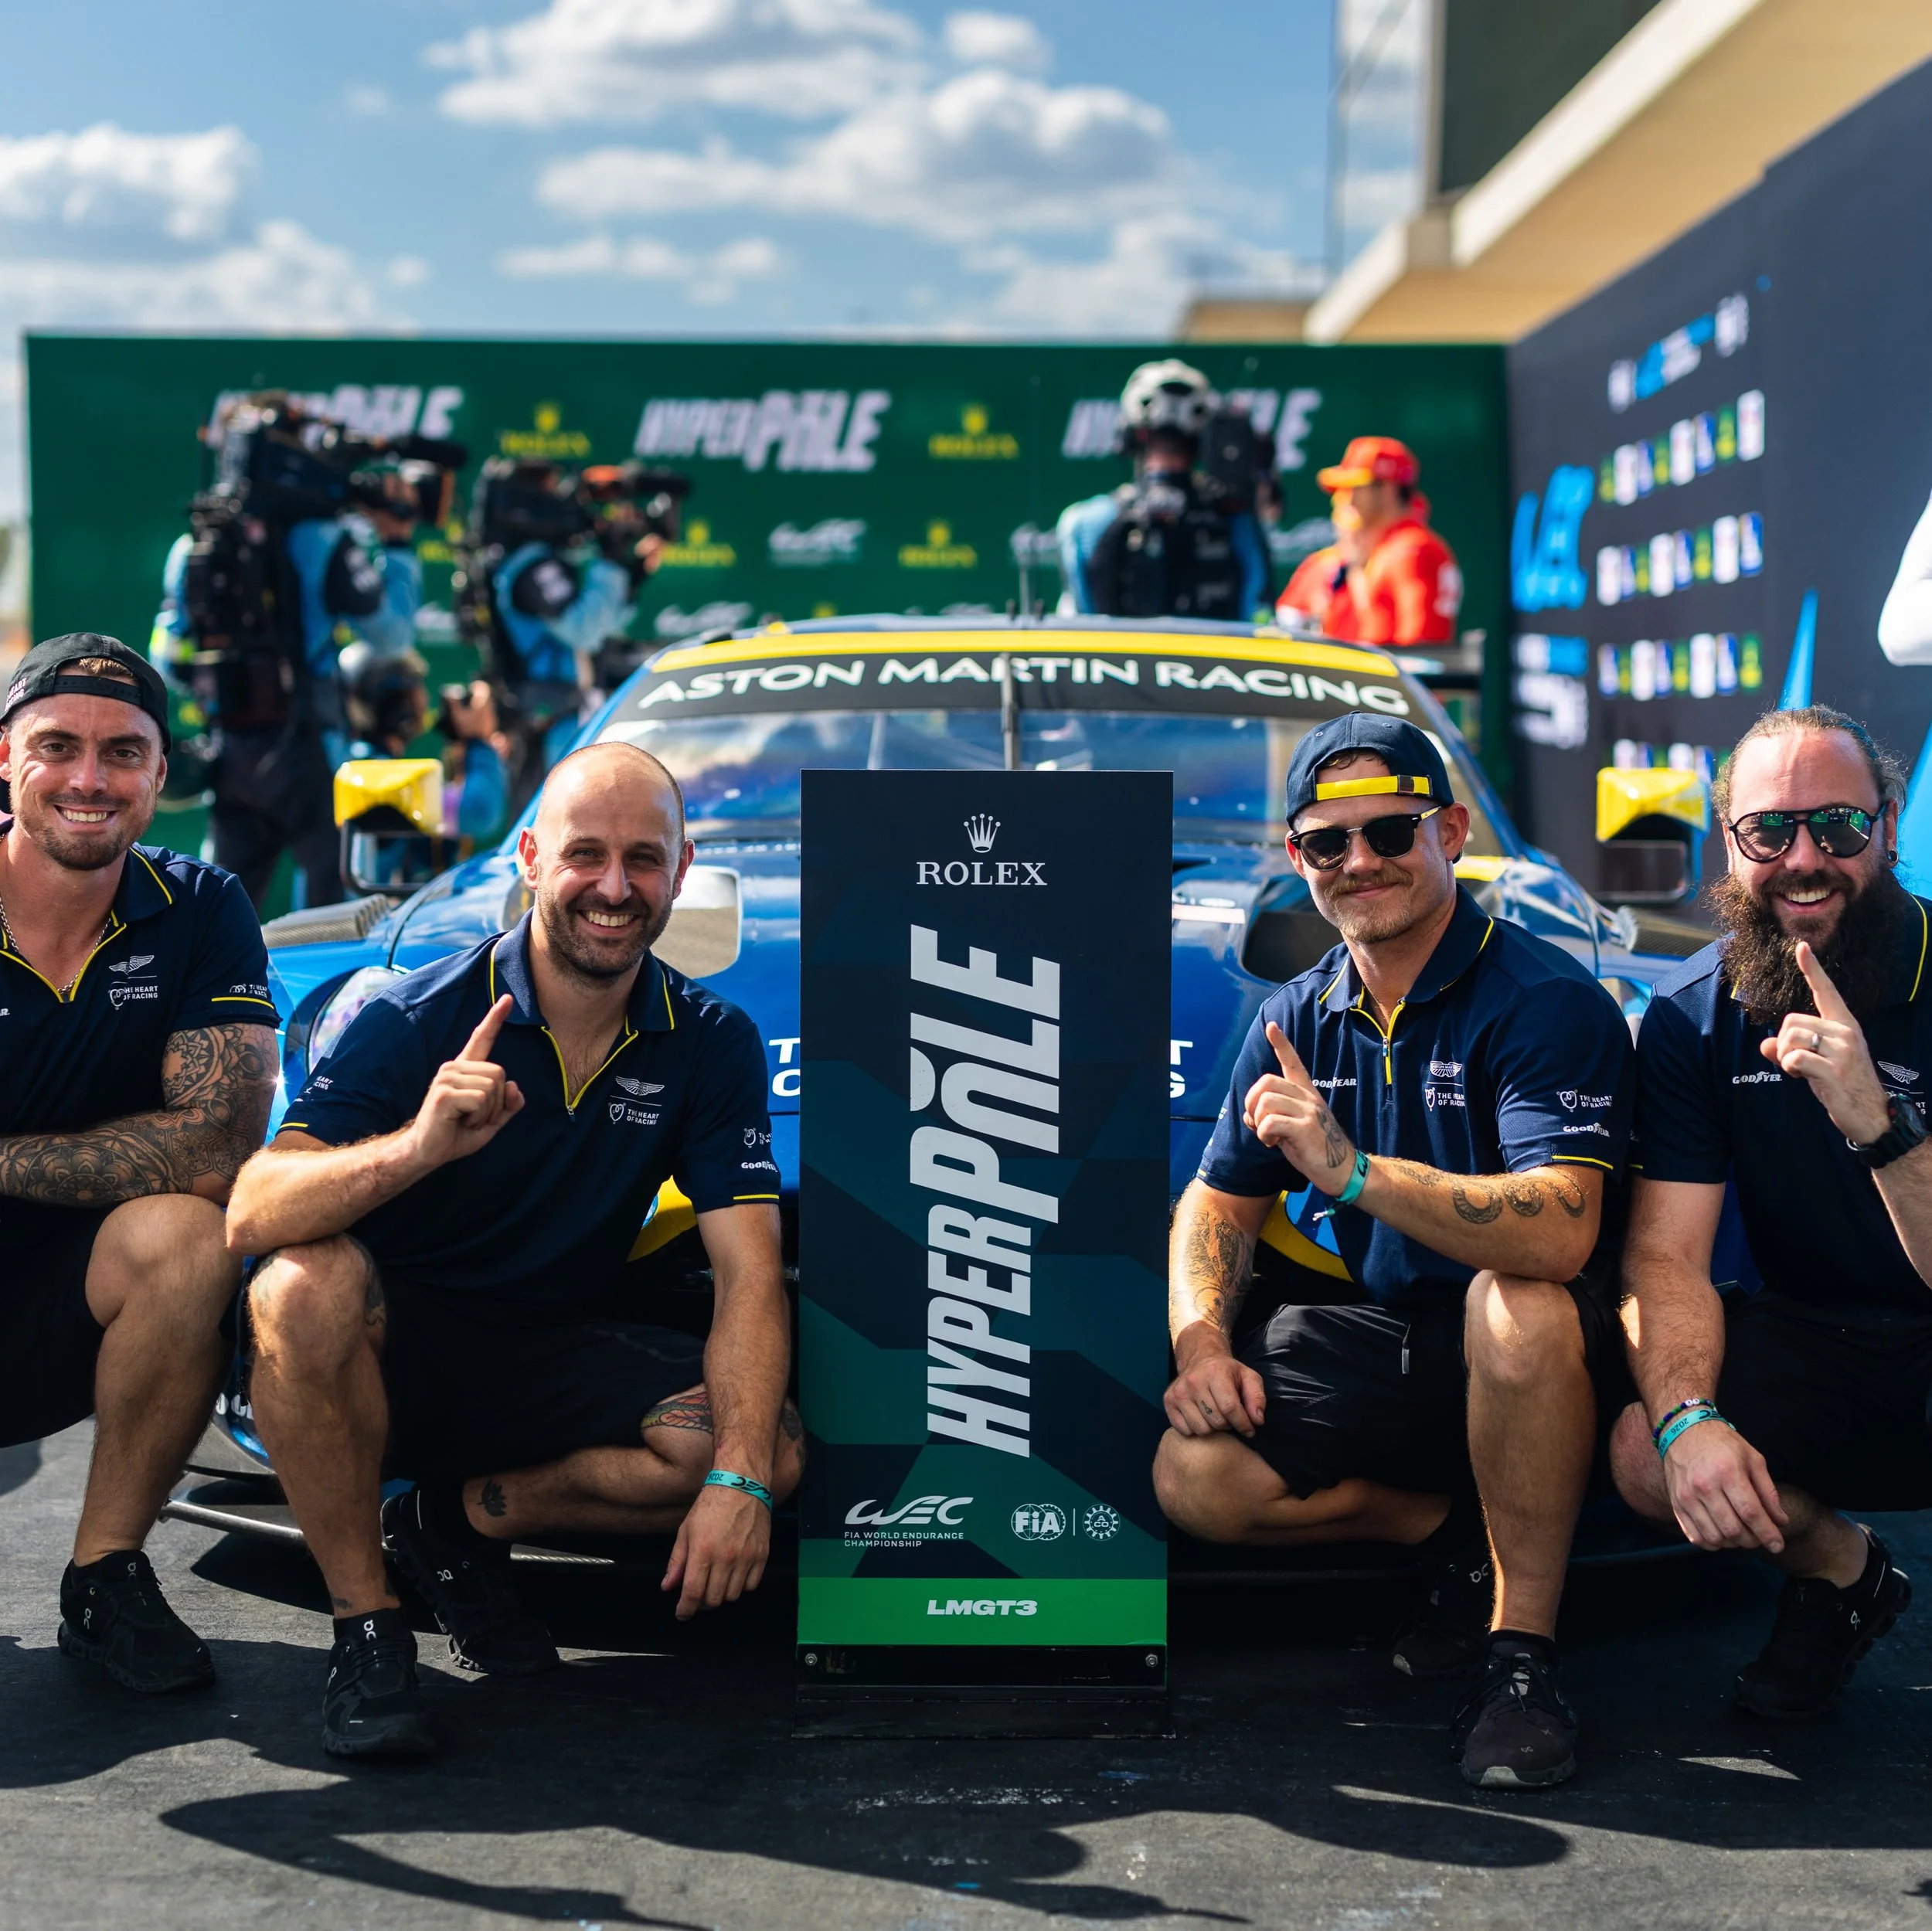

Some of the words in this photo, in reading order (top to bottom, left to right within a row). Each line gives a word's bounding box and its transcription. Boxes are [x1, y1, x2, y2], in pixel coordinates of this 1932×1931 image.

[638, 660, 866, 709] ASTON
[878, 657, 1138, 685] MARTIN
[1155, 661, 1410, 715] RACING
[917, 861, 1048, 886] ROLEX
[317, 1076, 334, 1084] EART
[1312, 1076, 1357, 1089] OODYEAR
[910, 924, 1060, 1458] HYPERPOLE
[1671, 1418, 1689, 1435] 2026
[845, 1495, 974, 1525] WEC
[927, 1600, 1038, 1616] LMGT3
